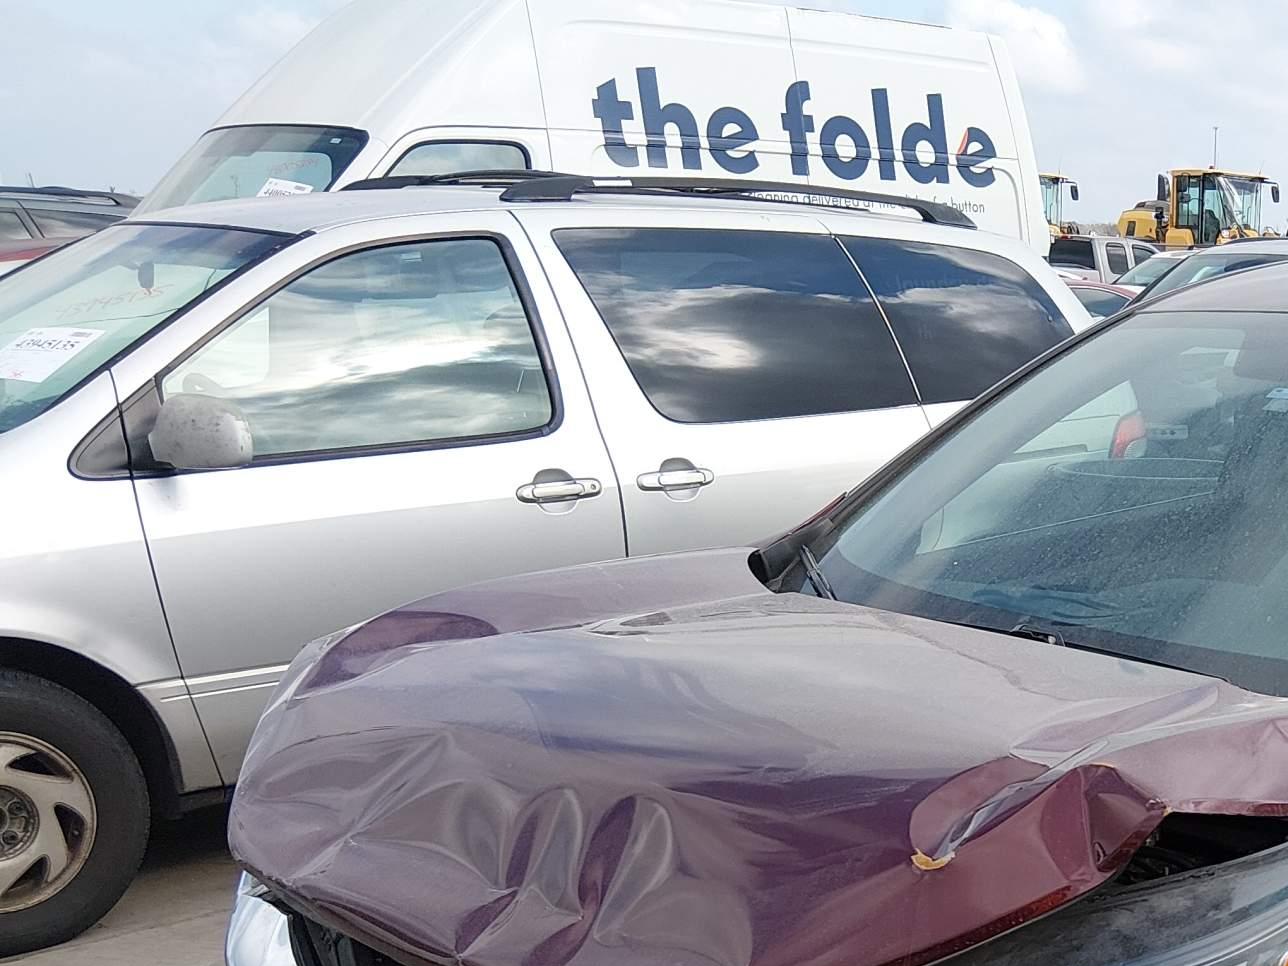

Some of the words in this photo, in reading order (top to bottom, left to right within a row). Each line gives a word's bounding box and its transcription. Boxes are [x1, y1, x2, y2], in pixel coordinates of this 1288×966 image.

[591, 67, 760, 177] the
[780, 80, 997, 188] folde
[951, 196, 985, 214] button
